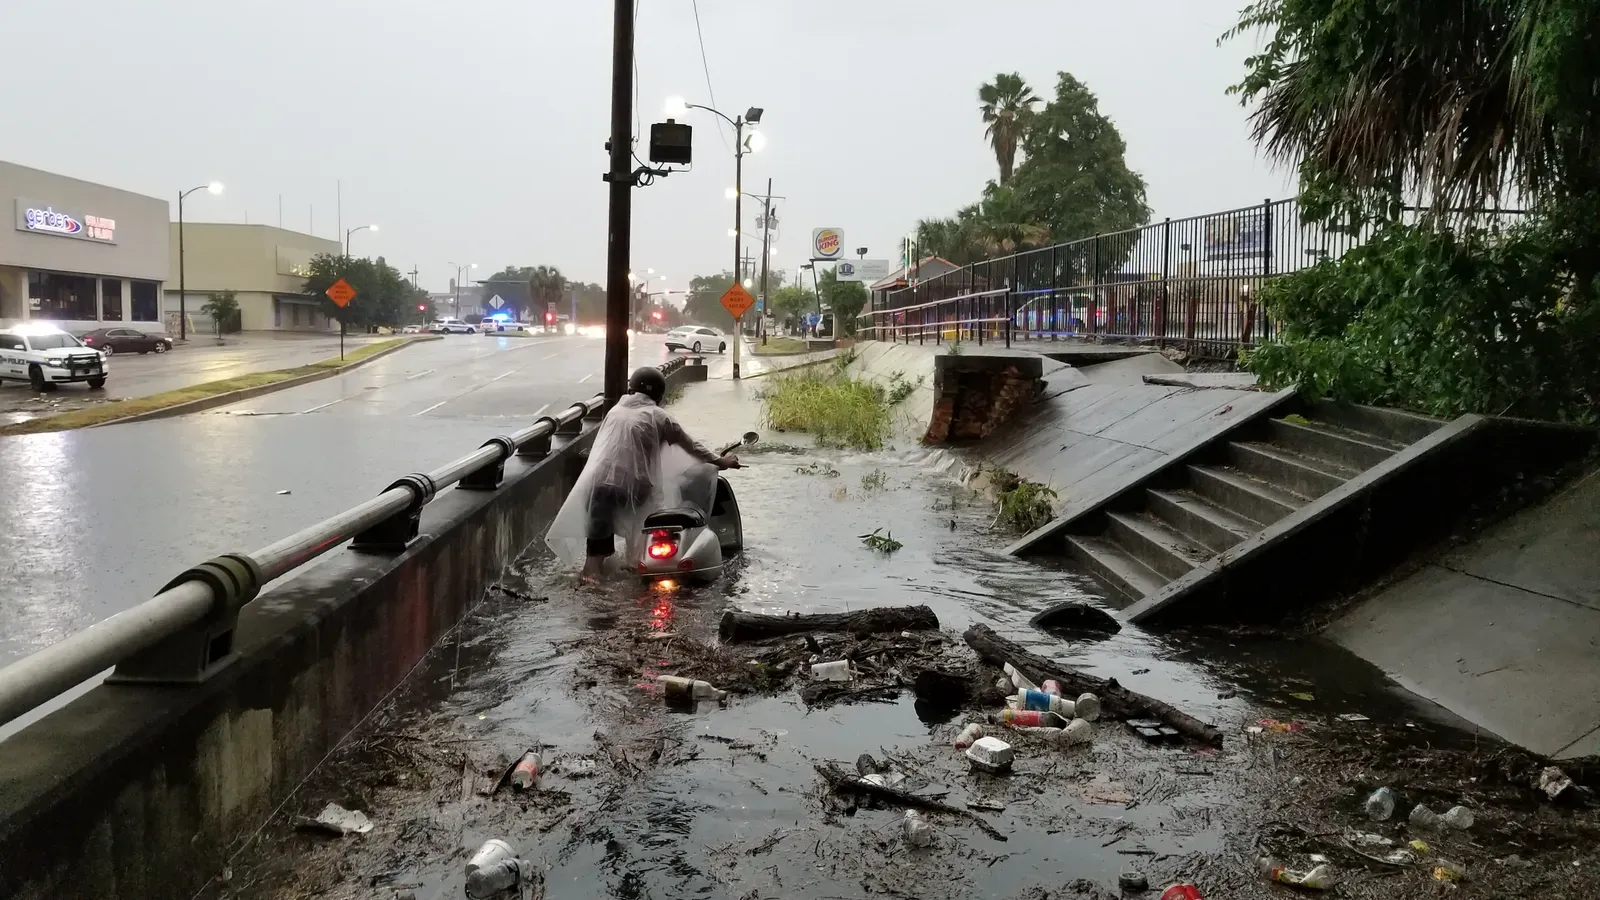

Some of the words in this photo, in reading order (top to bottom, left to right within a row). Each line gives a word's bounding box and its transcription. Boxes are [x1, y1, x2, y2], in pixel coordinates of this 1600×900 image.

[26, 207, 70, 229] gerber
[818, 234, 839, 245] BURGER
[818, 239, 839, 250] KING
